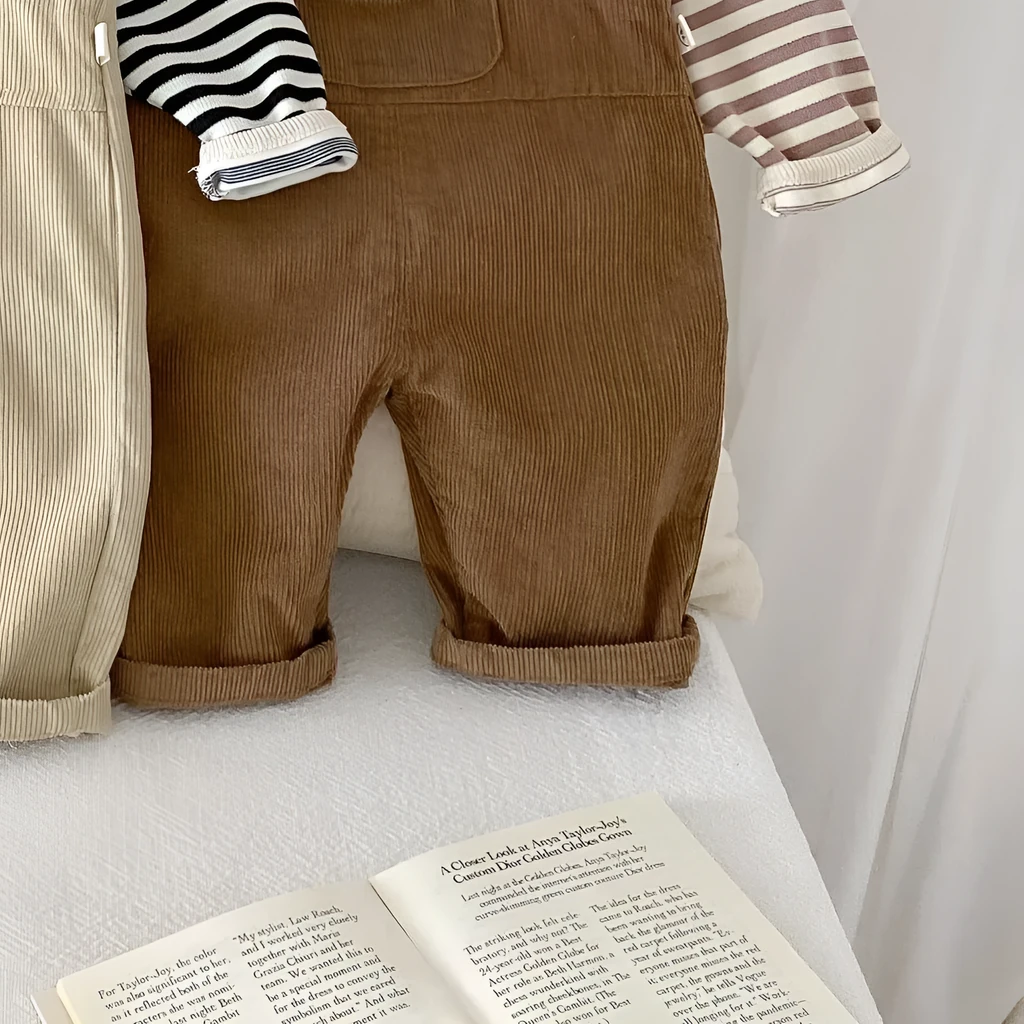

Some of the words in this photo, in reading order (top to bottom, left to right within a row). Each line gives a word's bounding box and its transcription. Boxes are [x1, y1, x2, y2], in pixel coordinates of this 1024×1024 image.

[440, 866, 452, 876] A
[450, 856, 487, 871] Closer
[486, 845, 519, 861] Look
[531, 836, 561, 852] Anya
[452, 866, 497, 884] Custom
[494, 859, 522, 871] Dior
[522, 846, 563, 864] Golden
[597, 827, 633, 842] Gown
[241, 942, 260, 957] and
[304, 922, 326, 933] very
[319, 941, 338, 955] and
[623, 942, 639, 954] red
[745, 943, 761, 955] red
[363, 954, 382, 967] and
[587, 965, 609, 977] with
[735, 971, 767, 982] Vogue
[672, 1006, 693, 1018] over
